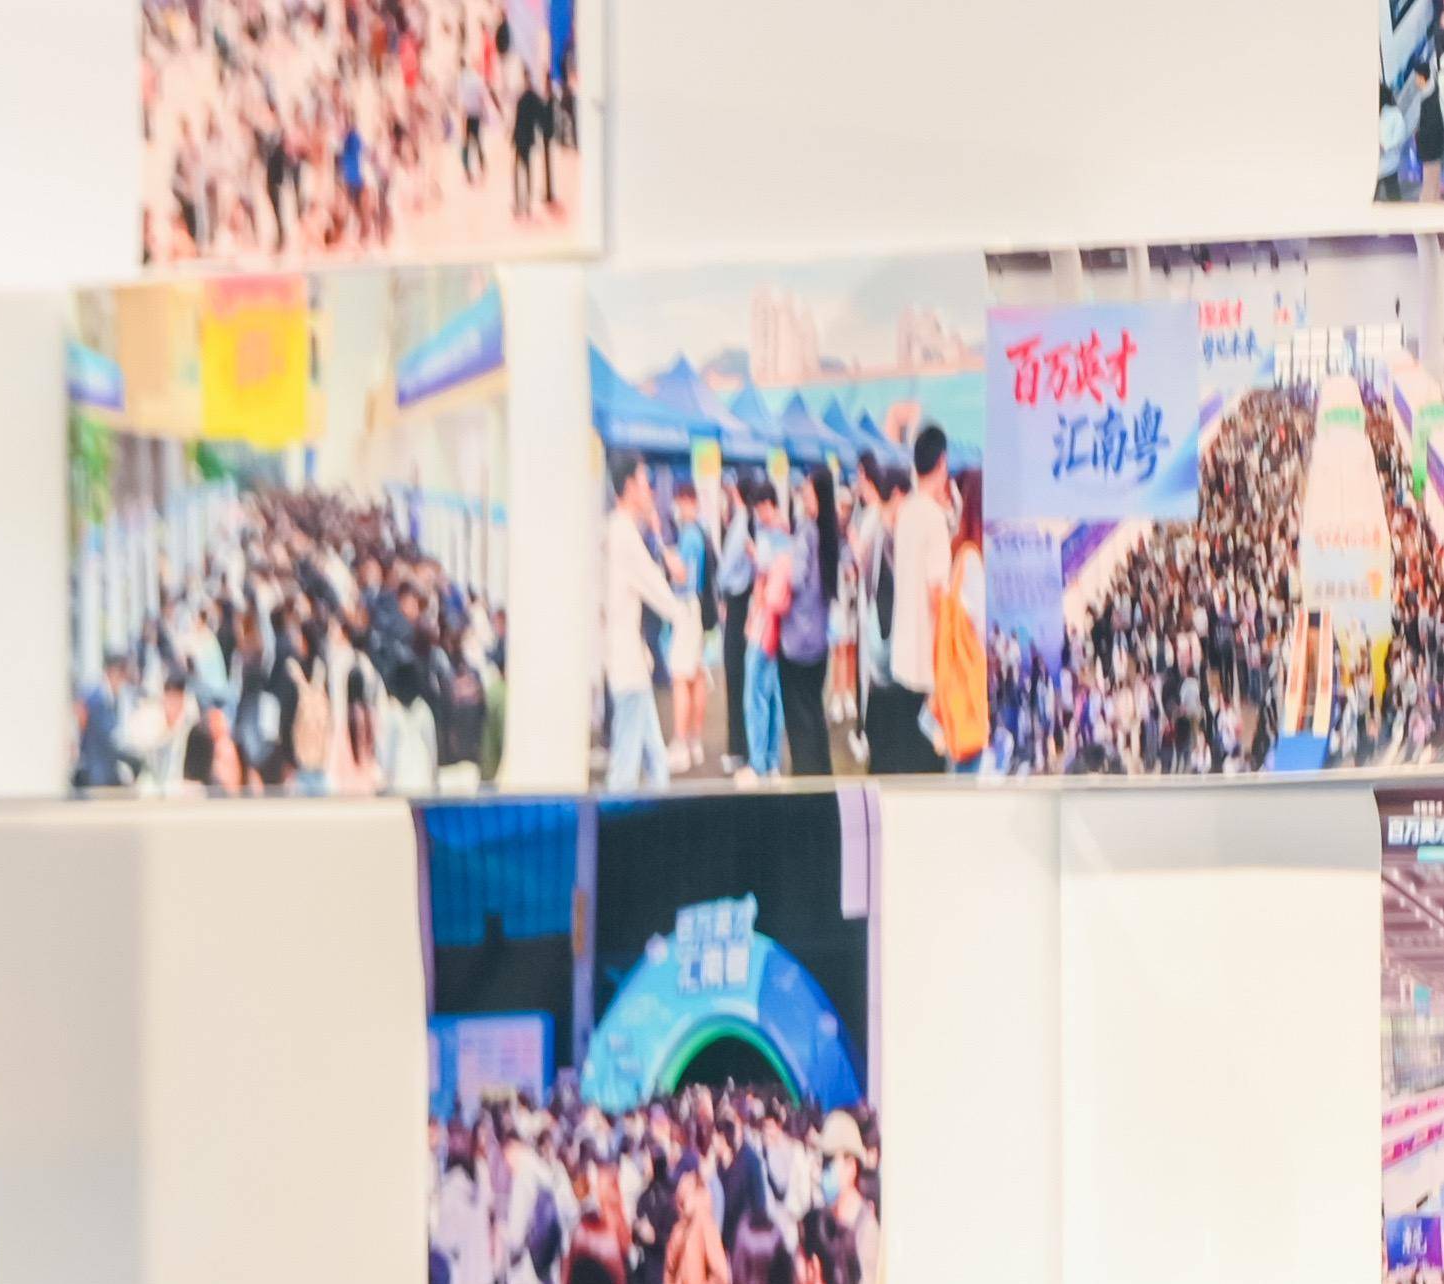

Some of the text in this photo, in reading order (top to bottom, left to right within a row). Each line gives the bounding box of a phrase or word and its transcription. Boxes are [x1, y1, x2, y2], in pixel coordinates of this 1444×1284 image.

[1007, 328, 1137, 406] 百万英才
[1052, 399, 1169, 482] 汇南粤
